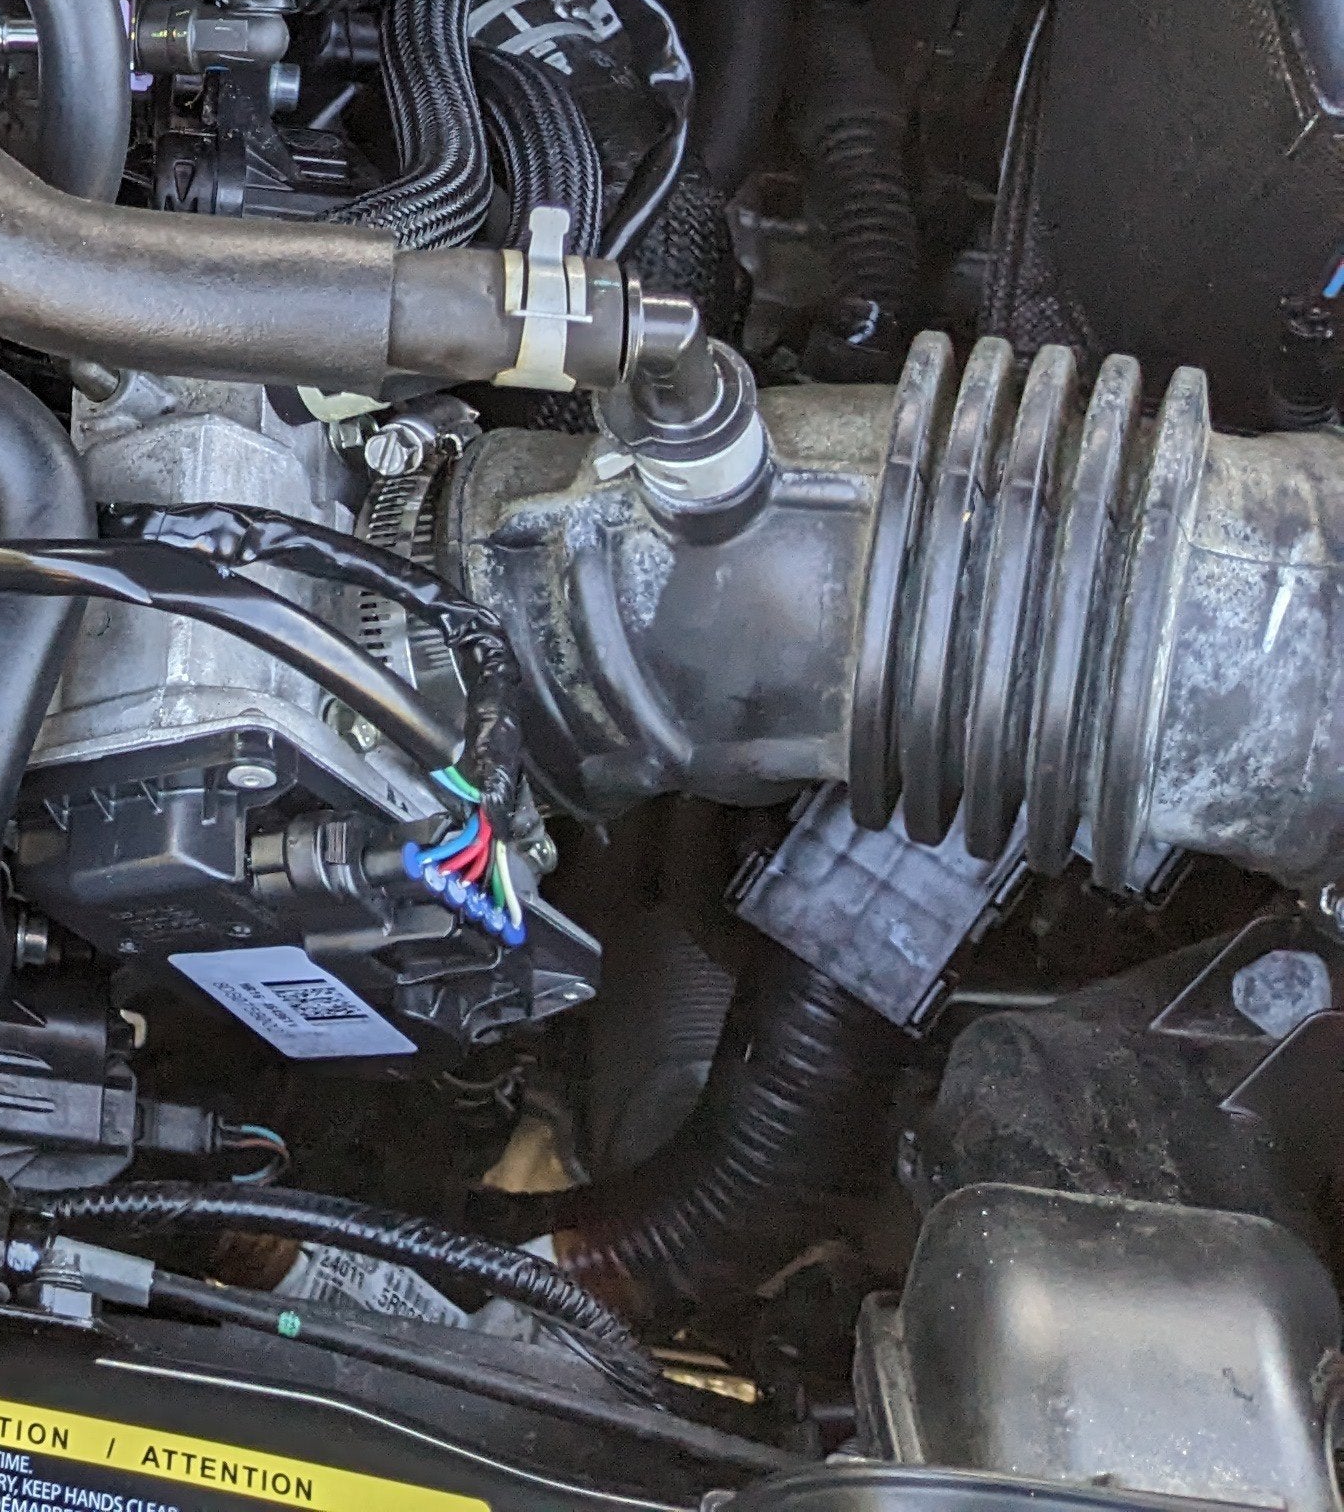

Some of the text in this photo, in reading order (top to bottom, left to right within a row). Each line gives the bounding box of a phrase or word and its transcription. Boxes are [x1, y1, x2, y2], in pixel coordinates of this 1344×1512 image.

[22, 1478, 62, 1501] KEEP
[64, 1485, 123, 1512] HANDS
[140, 1445, 315, 1502] ATTENTION
